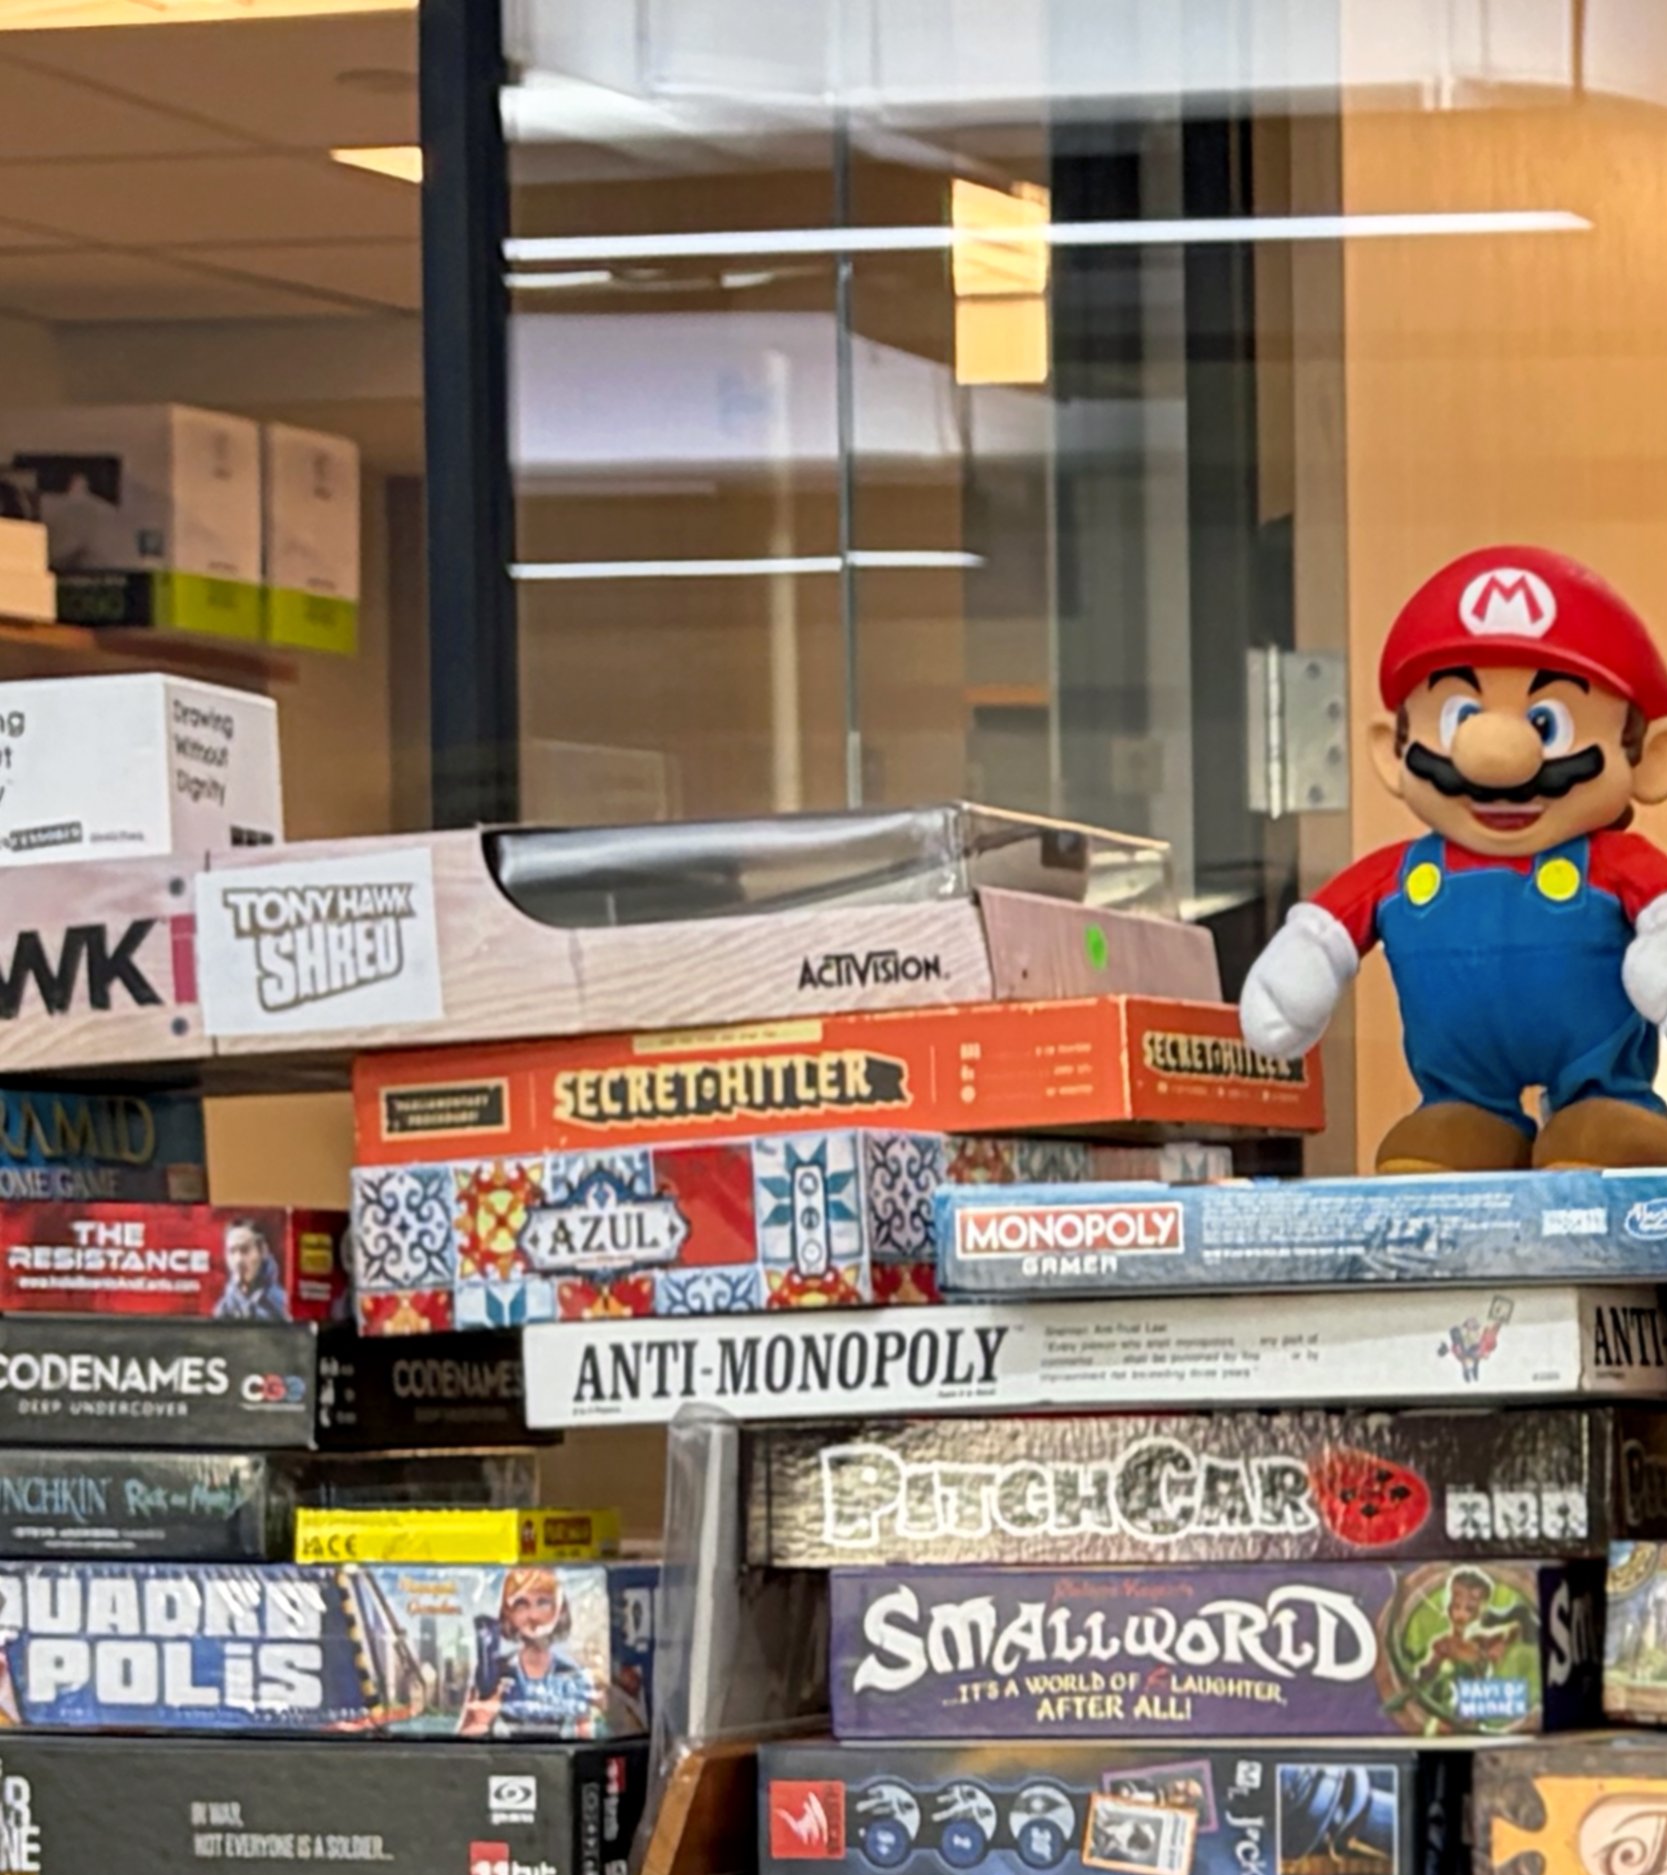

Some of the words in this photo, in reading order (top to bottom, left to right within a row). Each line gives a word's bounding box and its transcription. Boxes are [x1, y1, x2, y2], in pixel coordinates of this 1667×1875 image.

[173, 699, 234, 739] Drawing
[174, 734, 229, 768] Without
[176, 768, 226, 807] Dignity
[223, 885, 332, 938] TONY
[335, 882, 417, 918] HAWK
[257, 918, 404, 1010] SHRED
[553, 1064, 700, 1118] SECRET
[716, 1051, 872, 1104] HITLER
[70, 1220, 146, 1248] THE
[548, 1210, 661, 1255] AZUL
[965, 1207, 1177, 1252] MONOPOLY
[7, 1246, 212, 1273] RESISTANCE
[1022, 1254, 1118, 1276] GAMER
[572, 1325, 1010, 1404] ANTI-MONOPOLY
[1004, 1679, 1020, 1697] A
[1024, 1671, 1105, 1695] WORLD
[1110, 1672, 1140, 1691] OF
[1036, 1695, 1124, 1722] AFTER
[1133, 1695, 1192, 1721] ALL!
[194, 1834, 222, 1858] NOT
[225, 1834, 294, 1858] EVERYONE
[297, 1835, 311, 1858] IS
[314, 1836, 325, 1858] A
